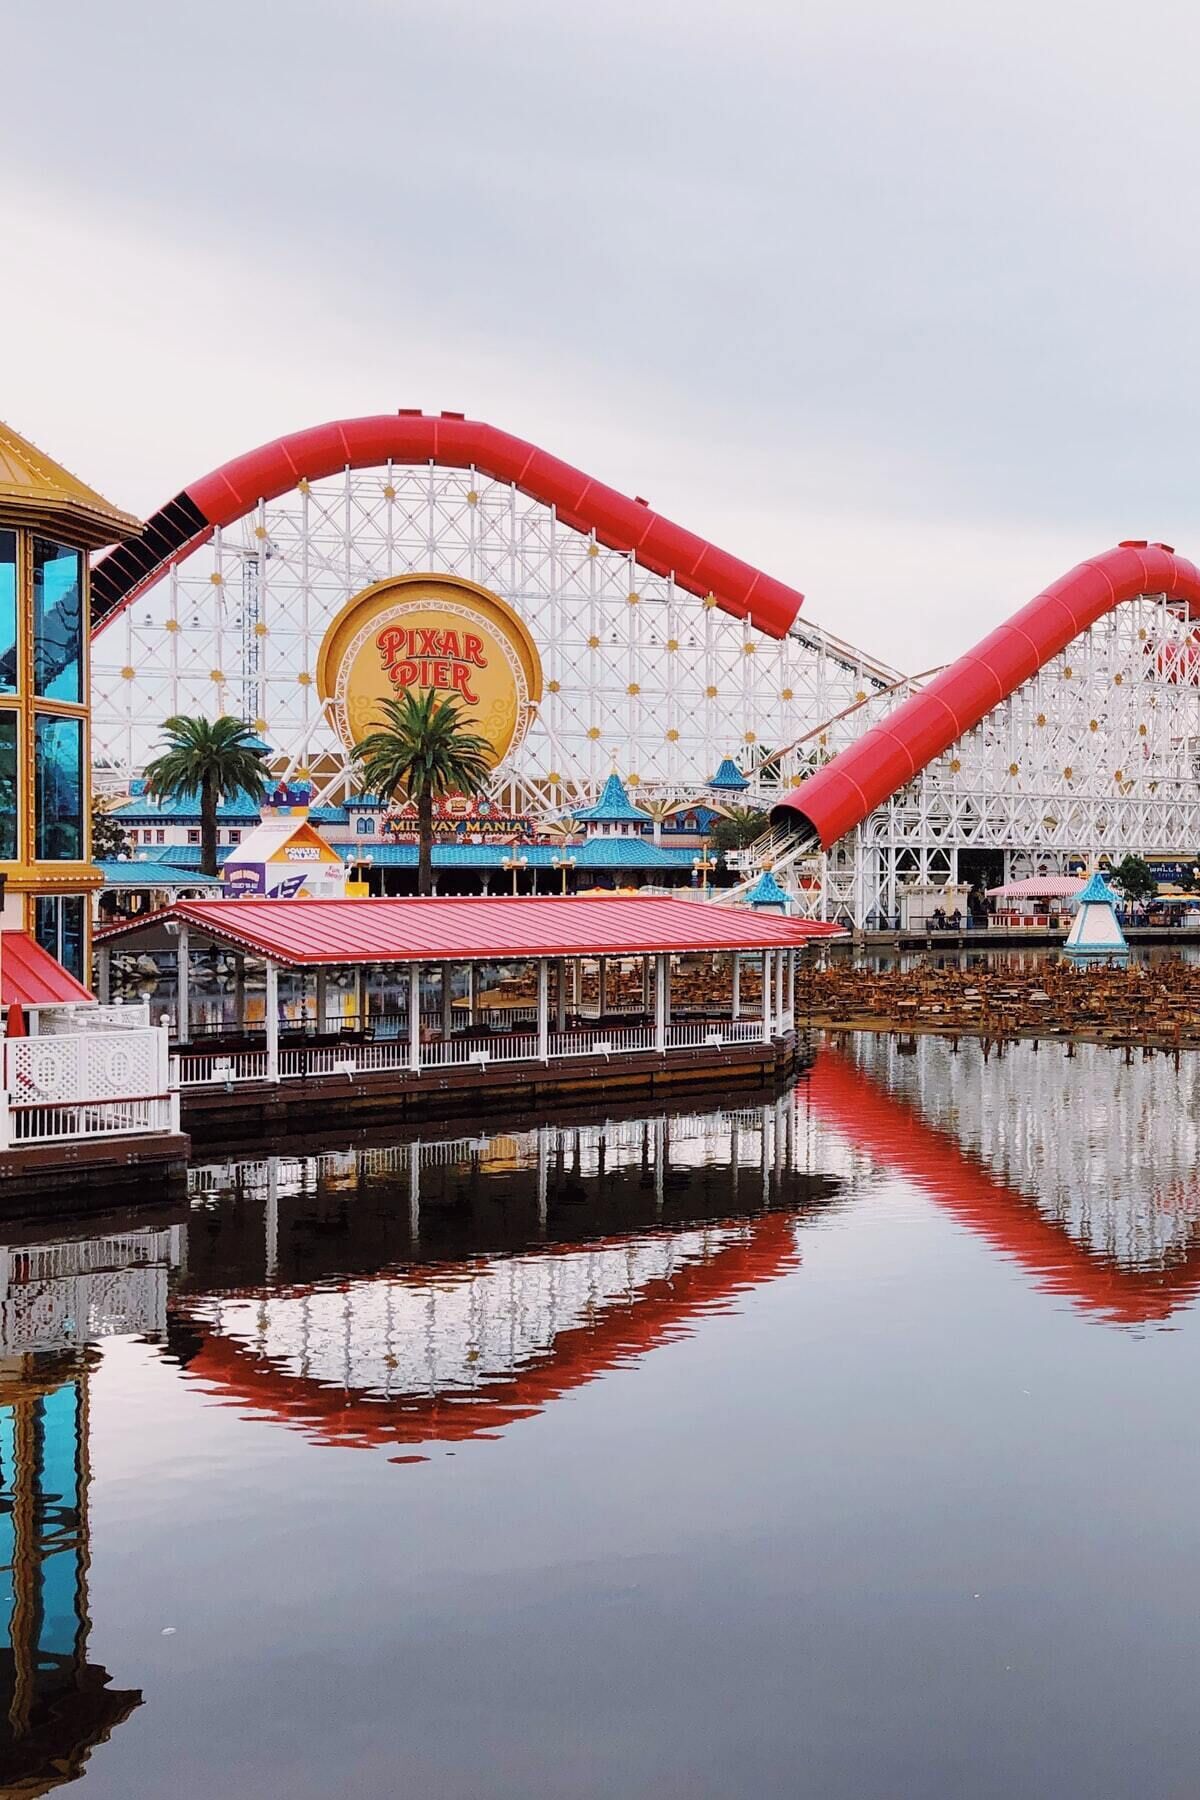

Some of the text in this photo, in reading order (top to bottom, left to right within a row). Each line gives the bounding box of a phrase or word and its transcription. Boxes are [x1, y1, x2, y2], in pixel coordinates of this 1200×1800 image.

[376, 625, 488, 669] PIXAR
[389, 660, 480, 704] PIER
[465, 820, 529, 832] MANIA!
[284, 847, 321, 856] POULTRY
